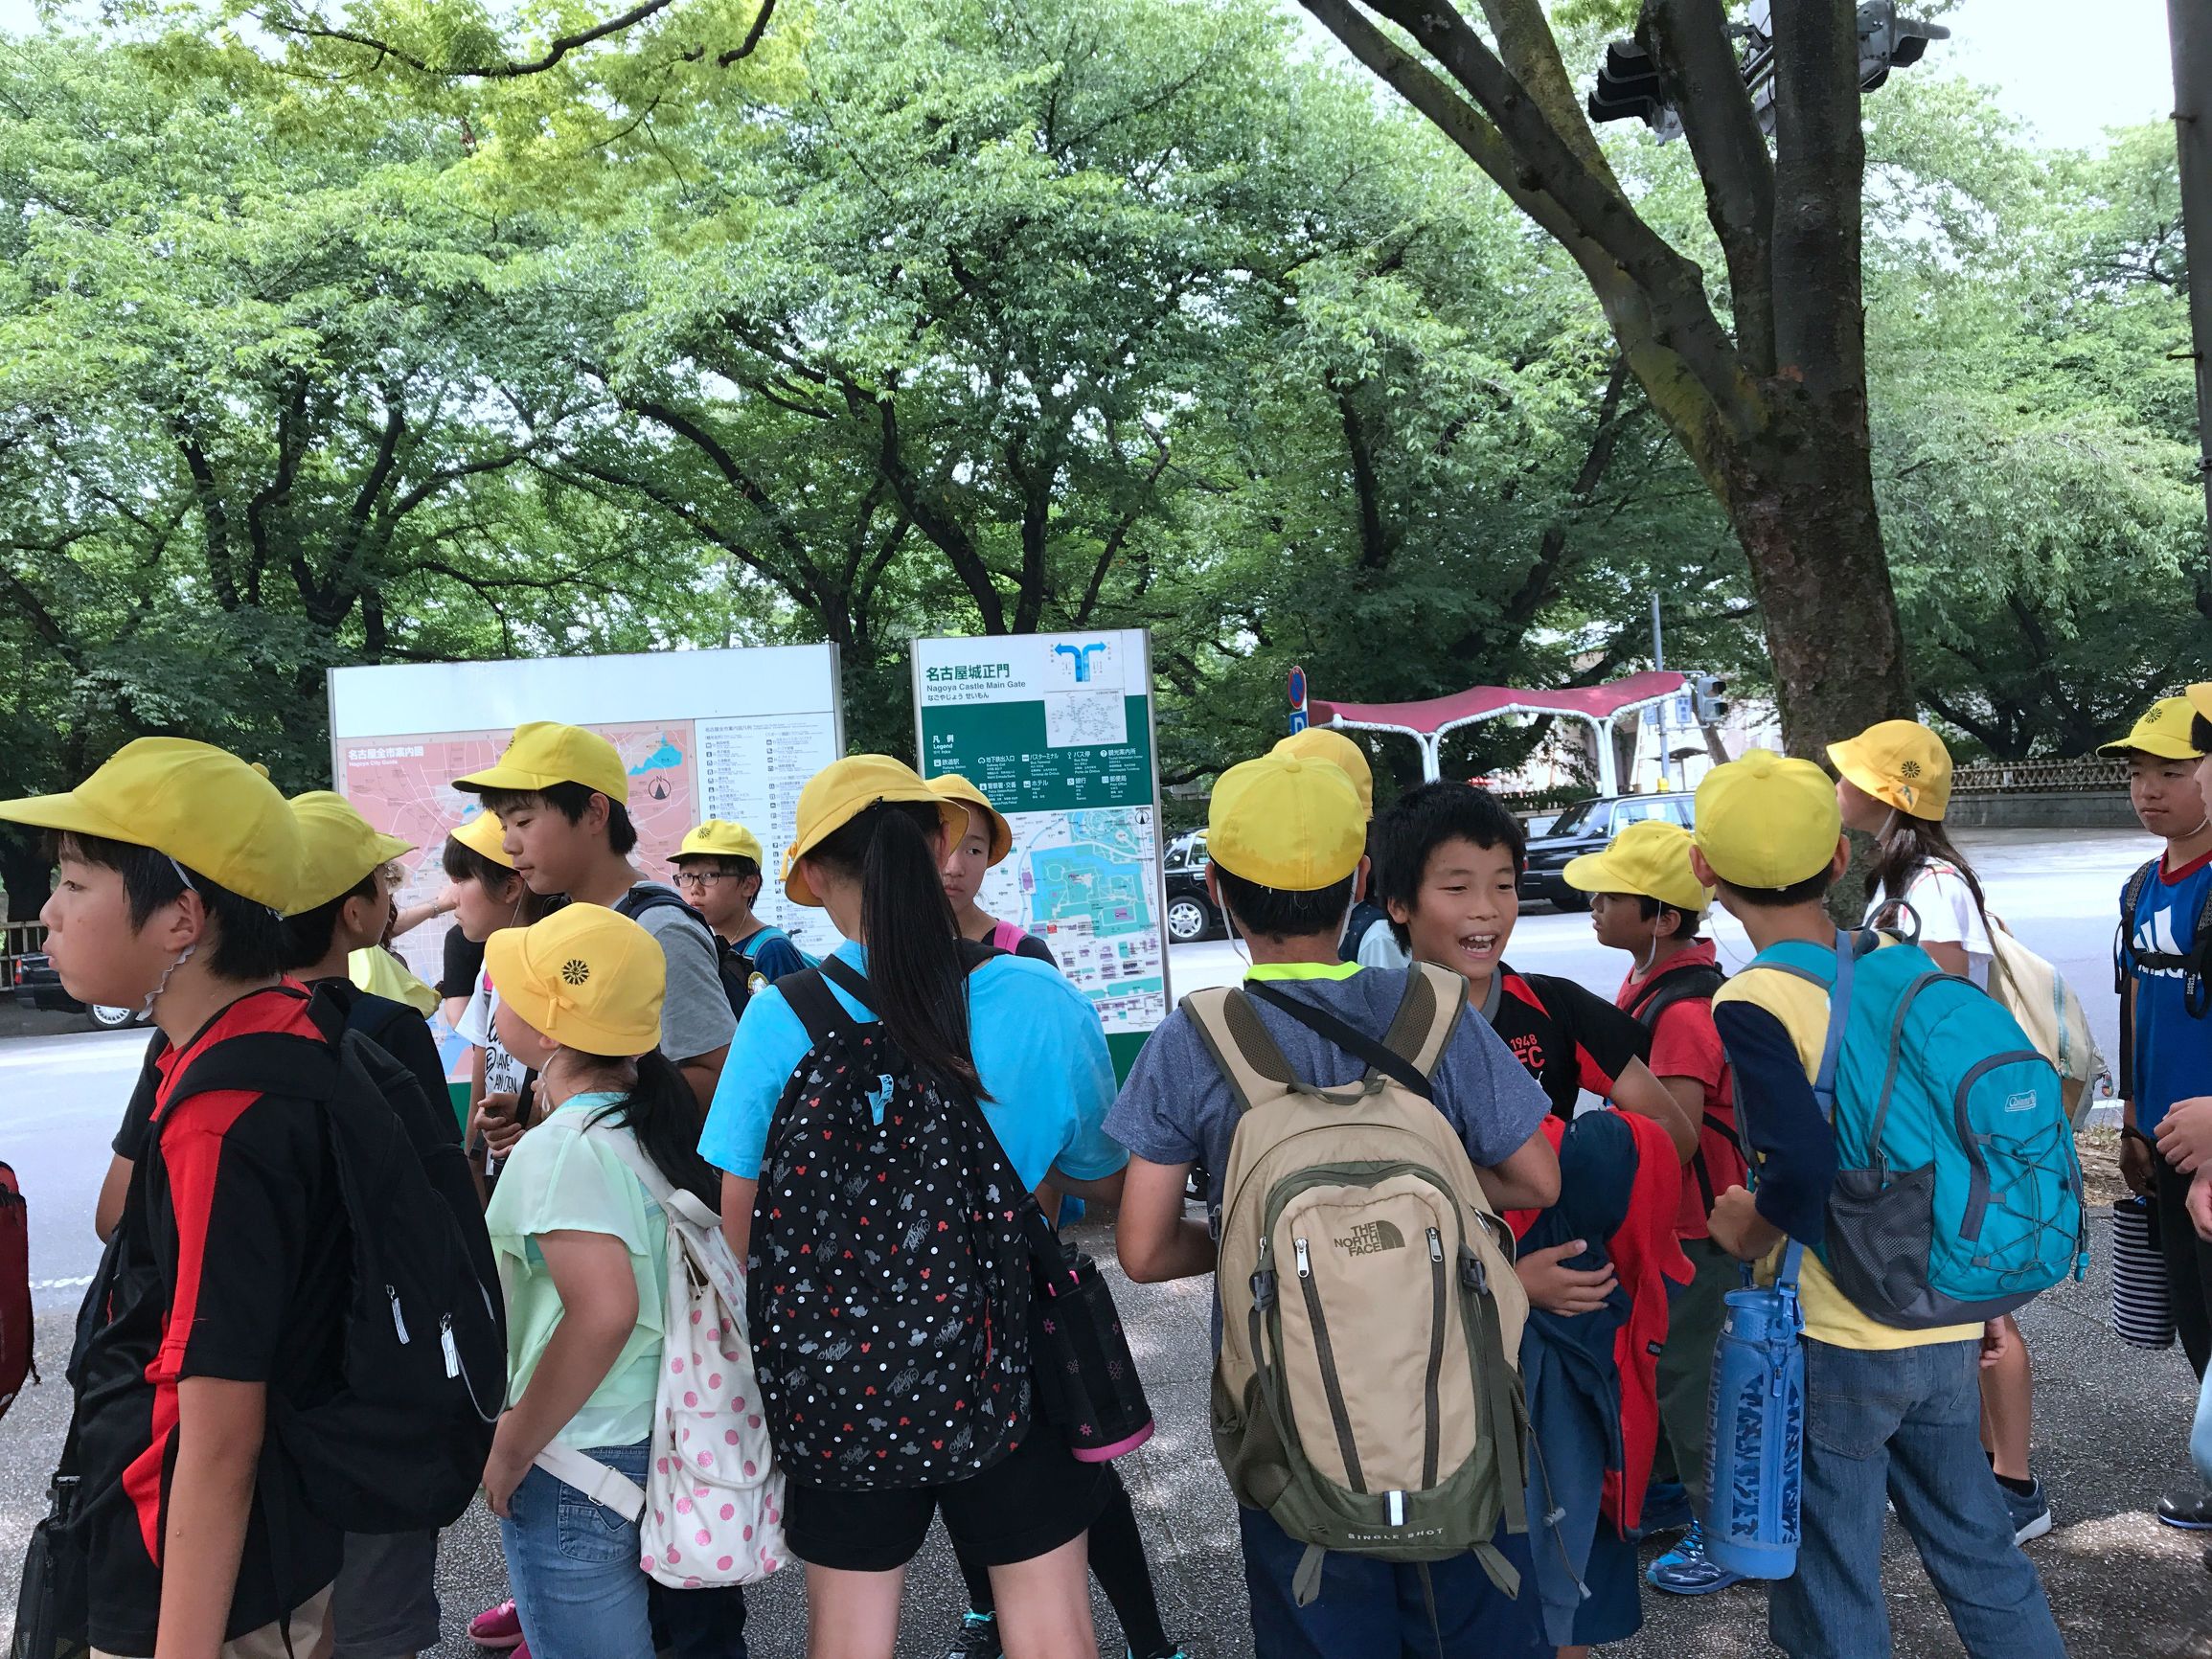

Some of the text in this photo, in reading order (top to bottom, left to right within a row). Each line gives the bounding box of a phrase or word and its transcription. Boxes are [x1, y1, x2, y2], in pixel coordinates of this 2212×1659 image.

[925, 663, 1011, 682] 名古屋城正門
[926, 679, 1026, 693] Nagoya Castle Main Gate
[927, 692, 990, 701] なごやじょう せいもん
[986, 755, 1015, 764] 地下鉄出入口
[1030, 752, 1060, 761] バスターミナル
[1510, 1034, 1538, 1050] 1948
[1350, 1221, 1377, 1237] THE
[1334, 1231, 1380, 1248] NORTH
[1348, 1241, 1381, 1257] FACE
[1407, 1527, 1444, 1538] SHOT
